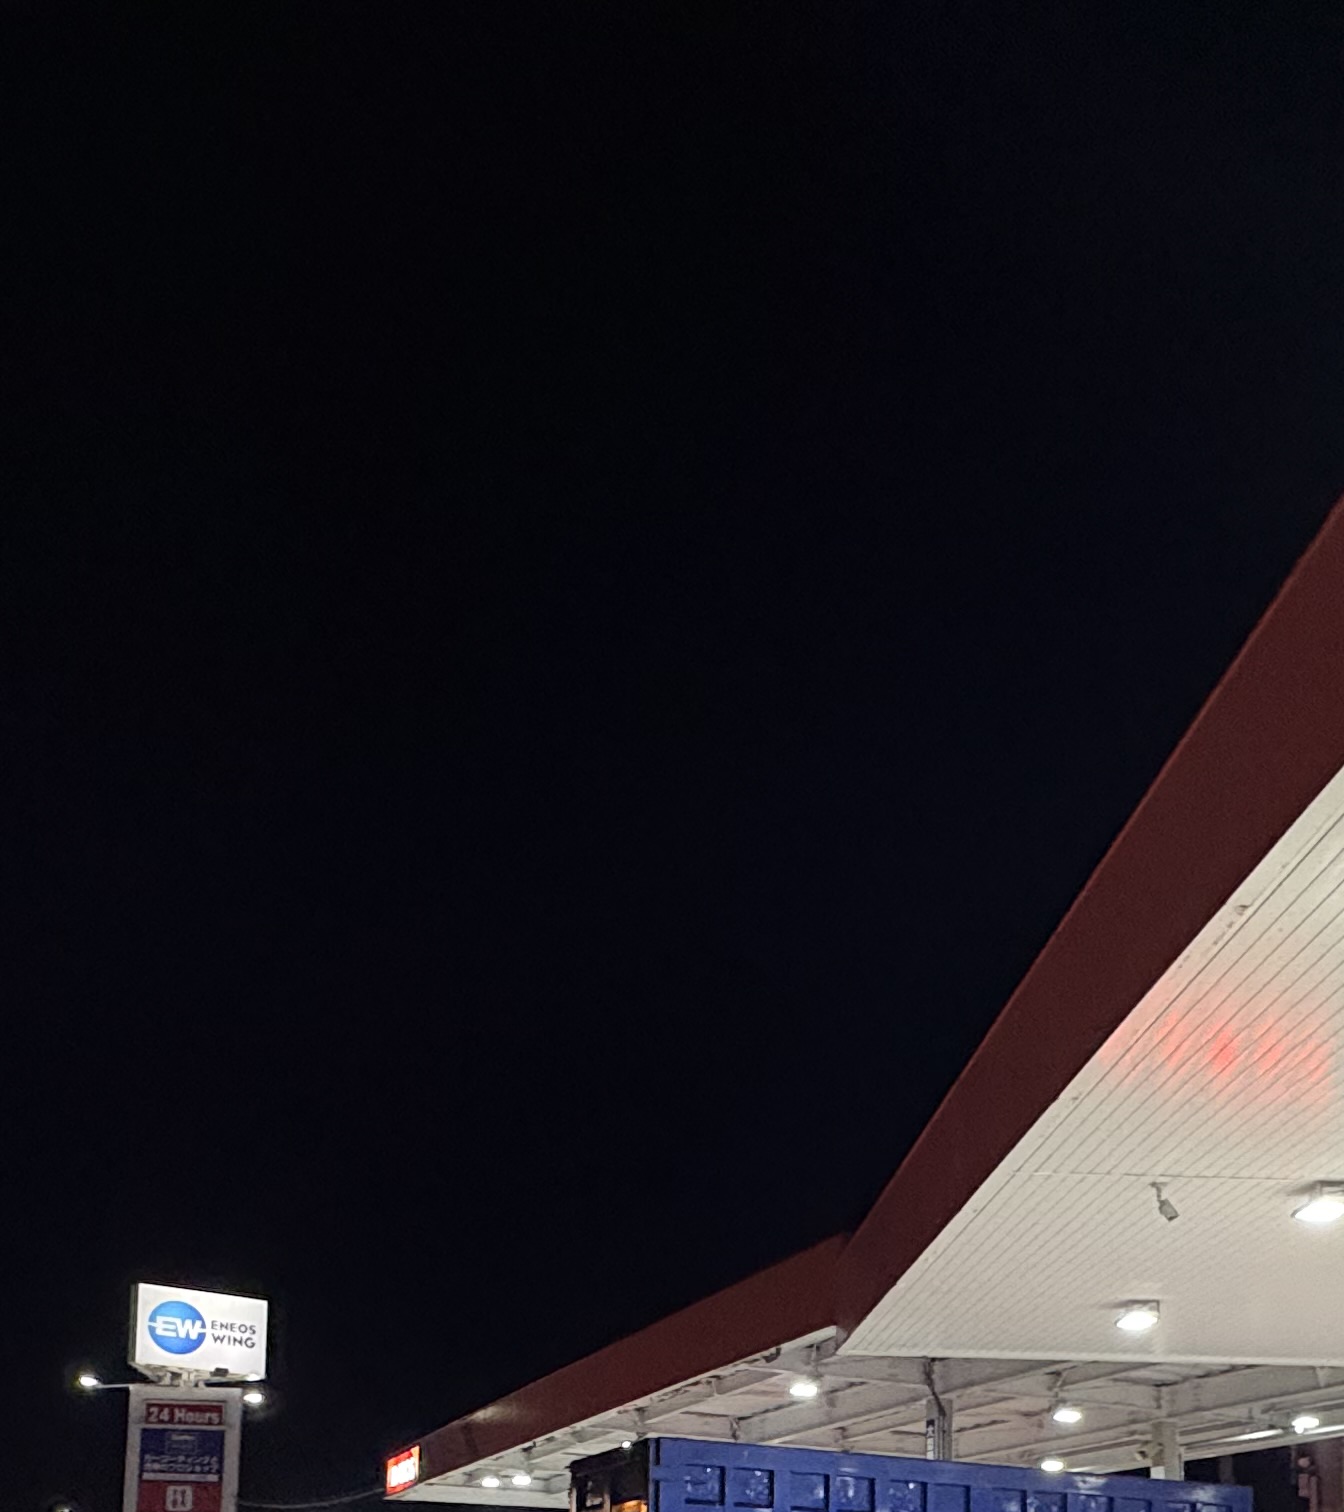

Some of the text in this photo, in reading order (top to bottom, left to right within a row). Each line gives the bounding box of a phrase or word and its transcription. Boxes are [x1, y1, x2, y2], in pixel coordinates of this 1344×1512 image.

[210, 1319, 257, 1336] ENEOS
[211, 1332, 257, 1349] WING
[148, 1406, 221, 1425] 24 Hours
